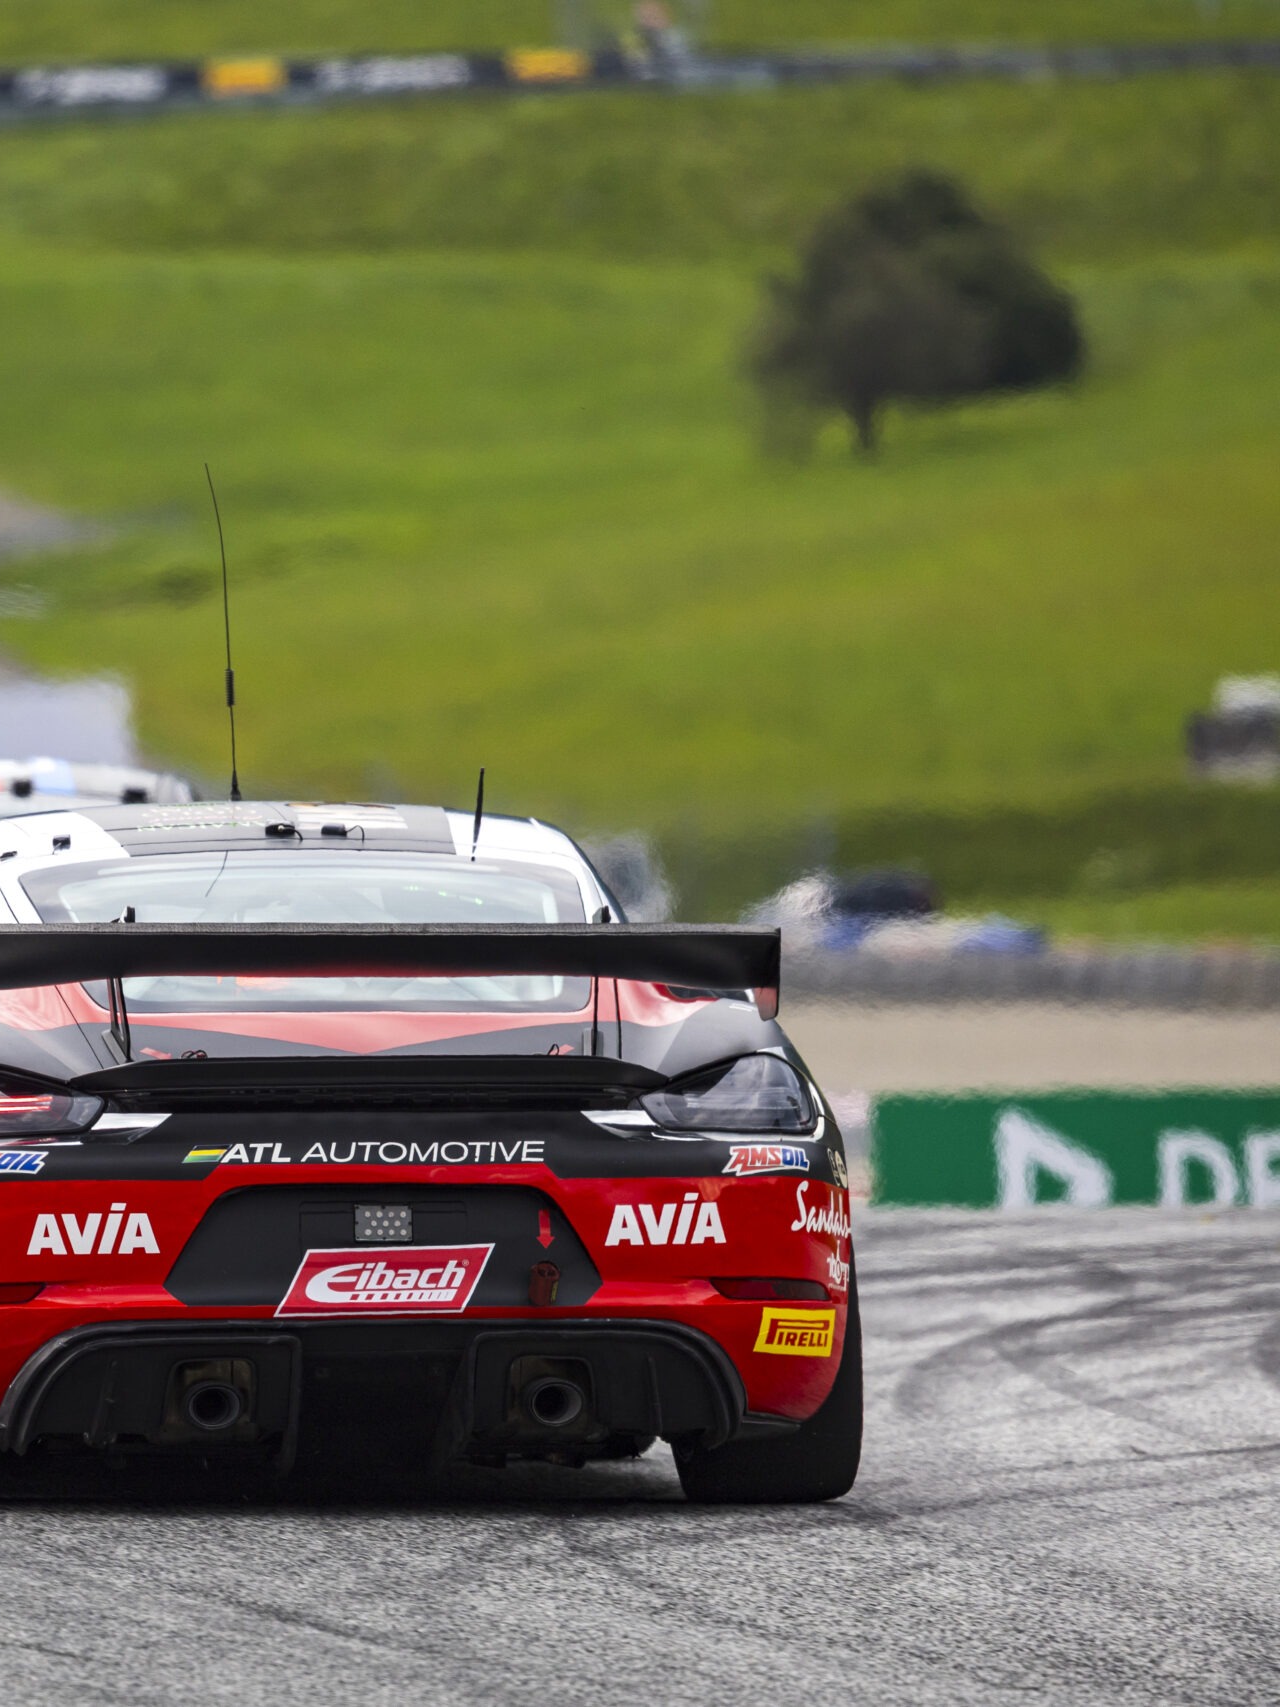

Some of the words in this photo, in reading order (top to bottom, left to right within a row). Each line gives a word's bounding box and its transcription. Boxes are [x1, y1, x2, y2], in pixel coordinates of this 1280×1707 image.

[221, 1142, 291, 1163] ATL
[300, 1140, 545, 1163] AUTOMOTIVE
[722, 1145, 809, 1176] AMSOIL
[27, 1203, 161, 1256] AVIA
[604, 1192, 727, 1247] AVIA
[791, 1180, 851, 1240] Sandals
[305, 1260, 461, 1303] Eibach
[761, 1317, 830, 1349] PIRELLI
